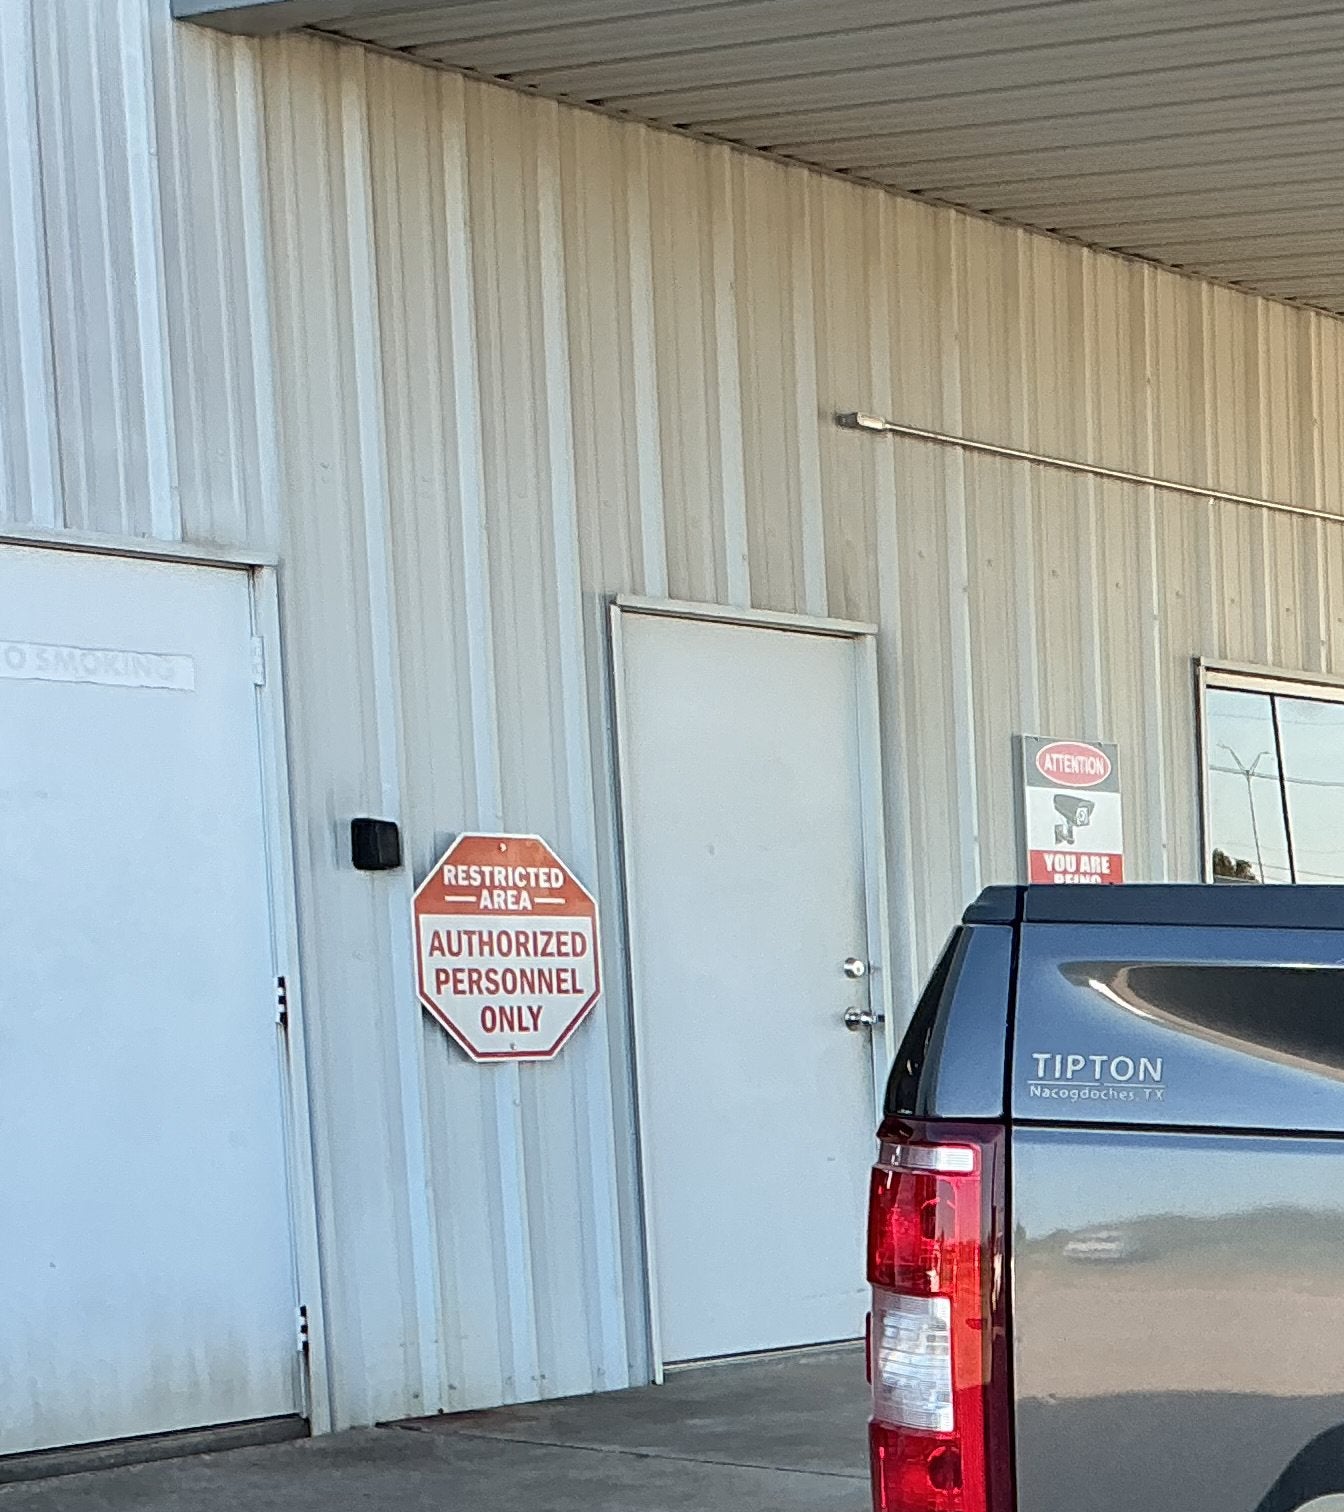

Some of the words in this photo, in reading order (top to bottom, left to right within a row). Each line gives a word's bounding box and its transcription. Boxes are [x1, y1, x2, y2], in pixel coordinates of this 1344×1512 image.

[1044, 753, 1105, 775] ATTENTION
[1043, 853, 1077, 872] YOU
[1080, 855, 1111, 874] ARE
[443, 865, 565, 889] RESTRICTED
[479, 889, 533, 911] AREA
[428, 929, 588, 958] AUTHORIZED
[434, 967, 585, 996] PERSONNEL
[480, 1005, 543, 1033] ONLY
[1032, 1053, 1164, 1082] TIPTON
[1143, 1088, 1165, 1101] TX
